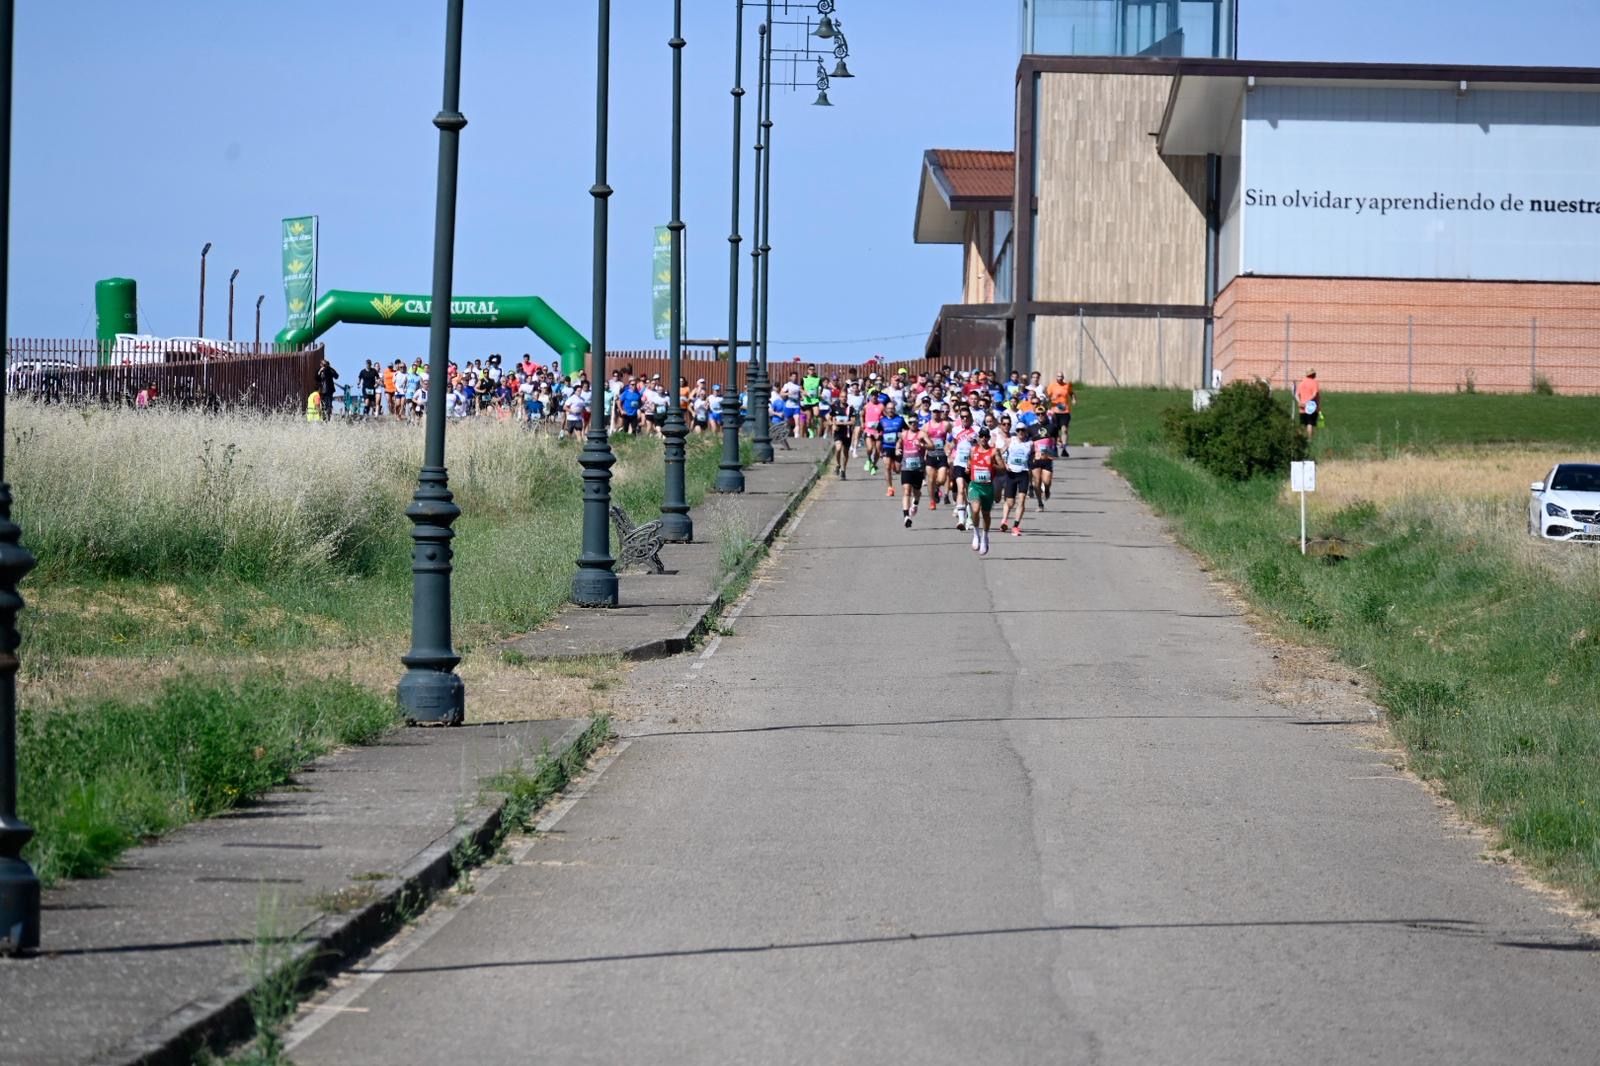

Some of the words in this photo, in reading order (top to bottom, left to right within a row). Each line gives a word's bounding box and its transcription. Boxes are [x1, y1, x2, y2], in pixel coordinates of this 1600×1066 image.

[1245, 188, 1277, 207] Sin
[1282, 189, 1352, 209] olvidar
[1355, 197, 1367, 215] y
[1368, 191, 1495, 215] aprendiendo
[1500, 193, 1524, 211] de
